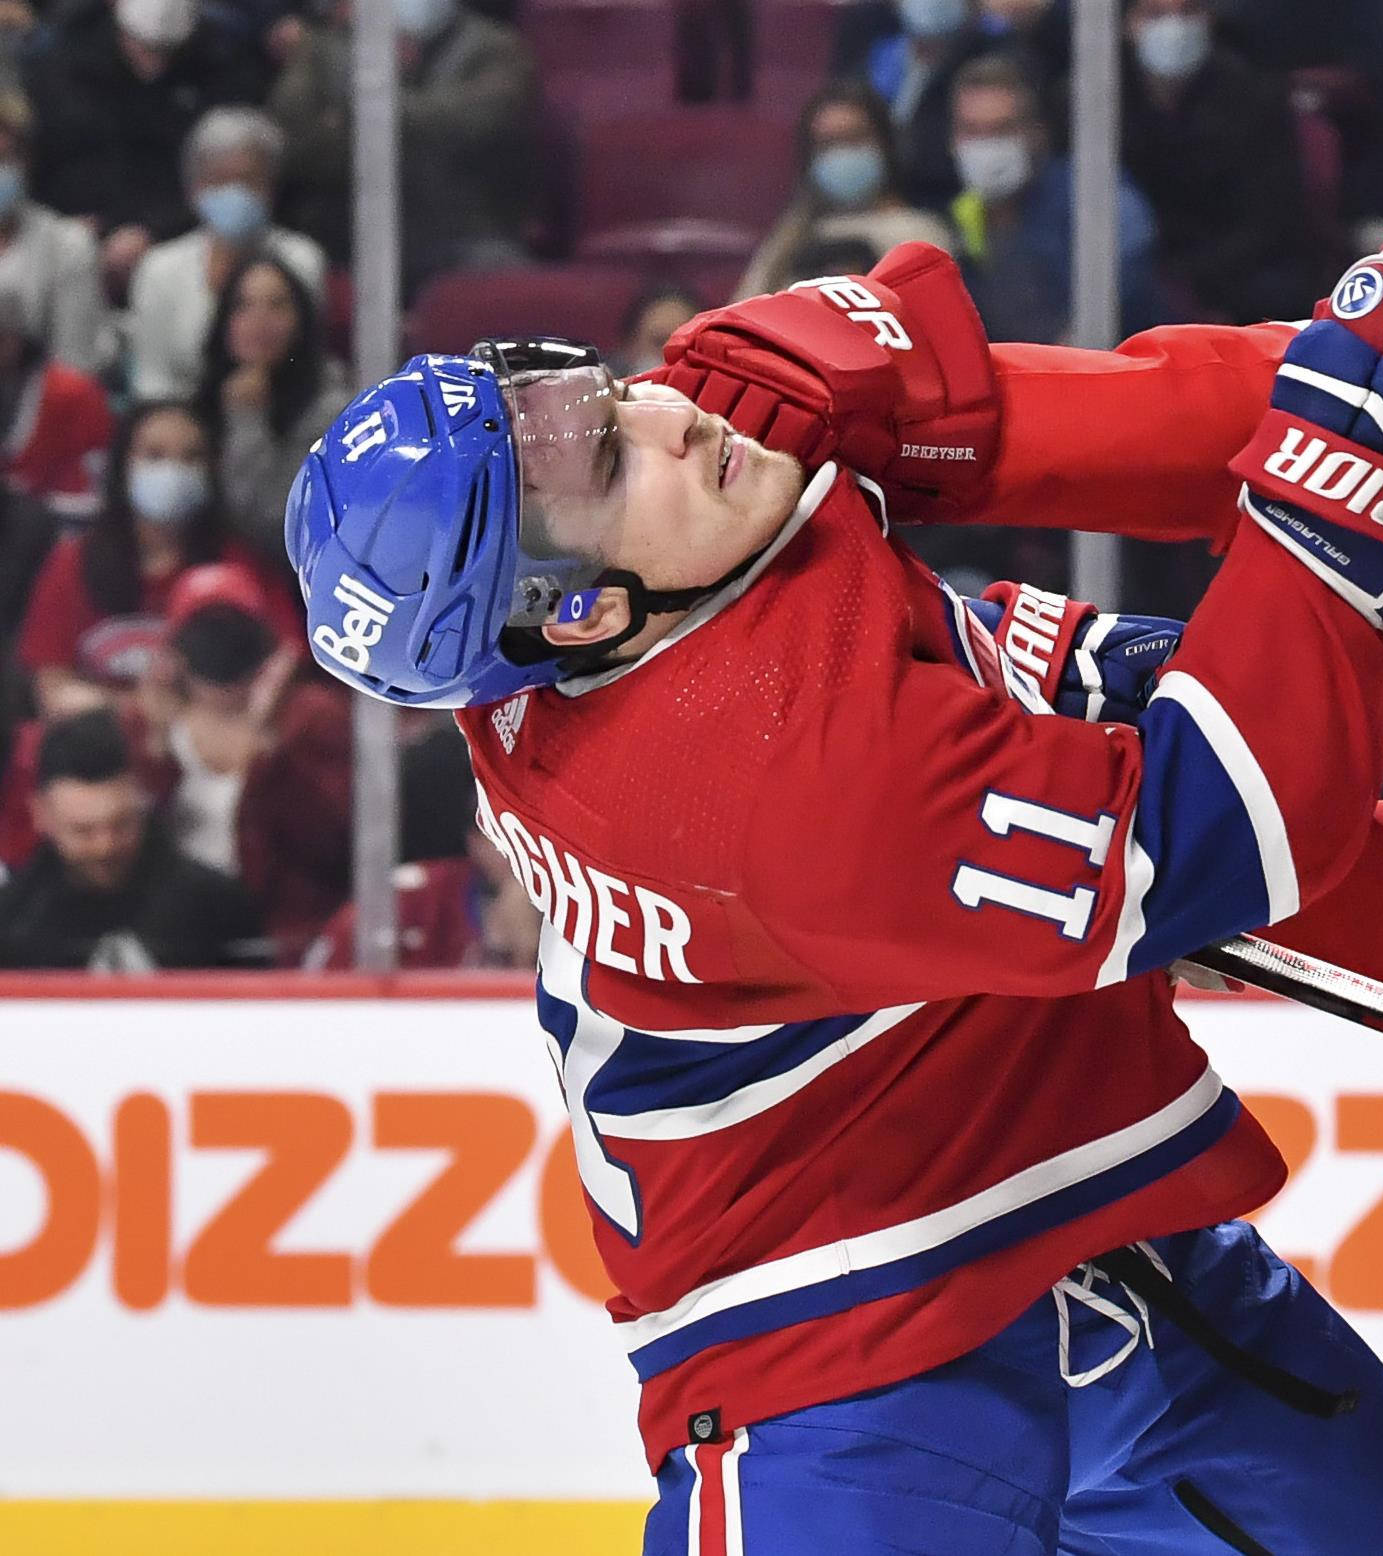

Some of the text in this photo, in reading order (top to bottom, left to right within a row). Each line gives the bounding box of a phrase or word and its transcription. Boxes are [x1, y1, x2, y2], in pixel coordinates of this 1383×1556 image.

[900, 443, 977, 462] DEKEYSER
[1264, 503, 1352, 566] GALLAGHER
[312, 573, 396, 674] Bell
[951, 791, 1117, 942] 11
